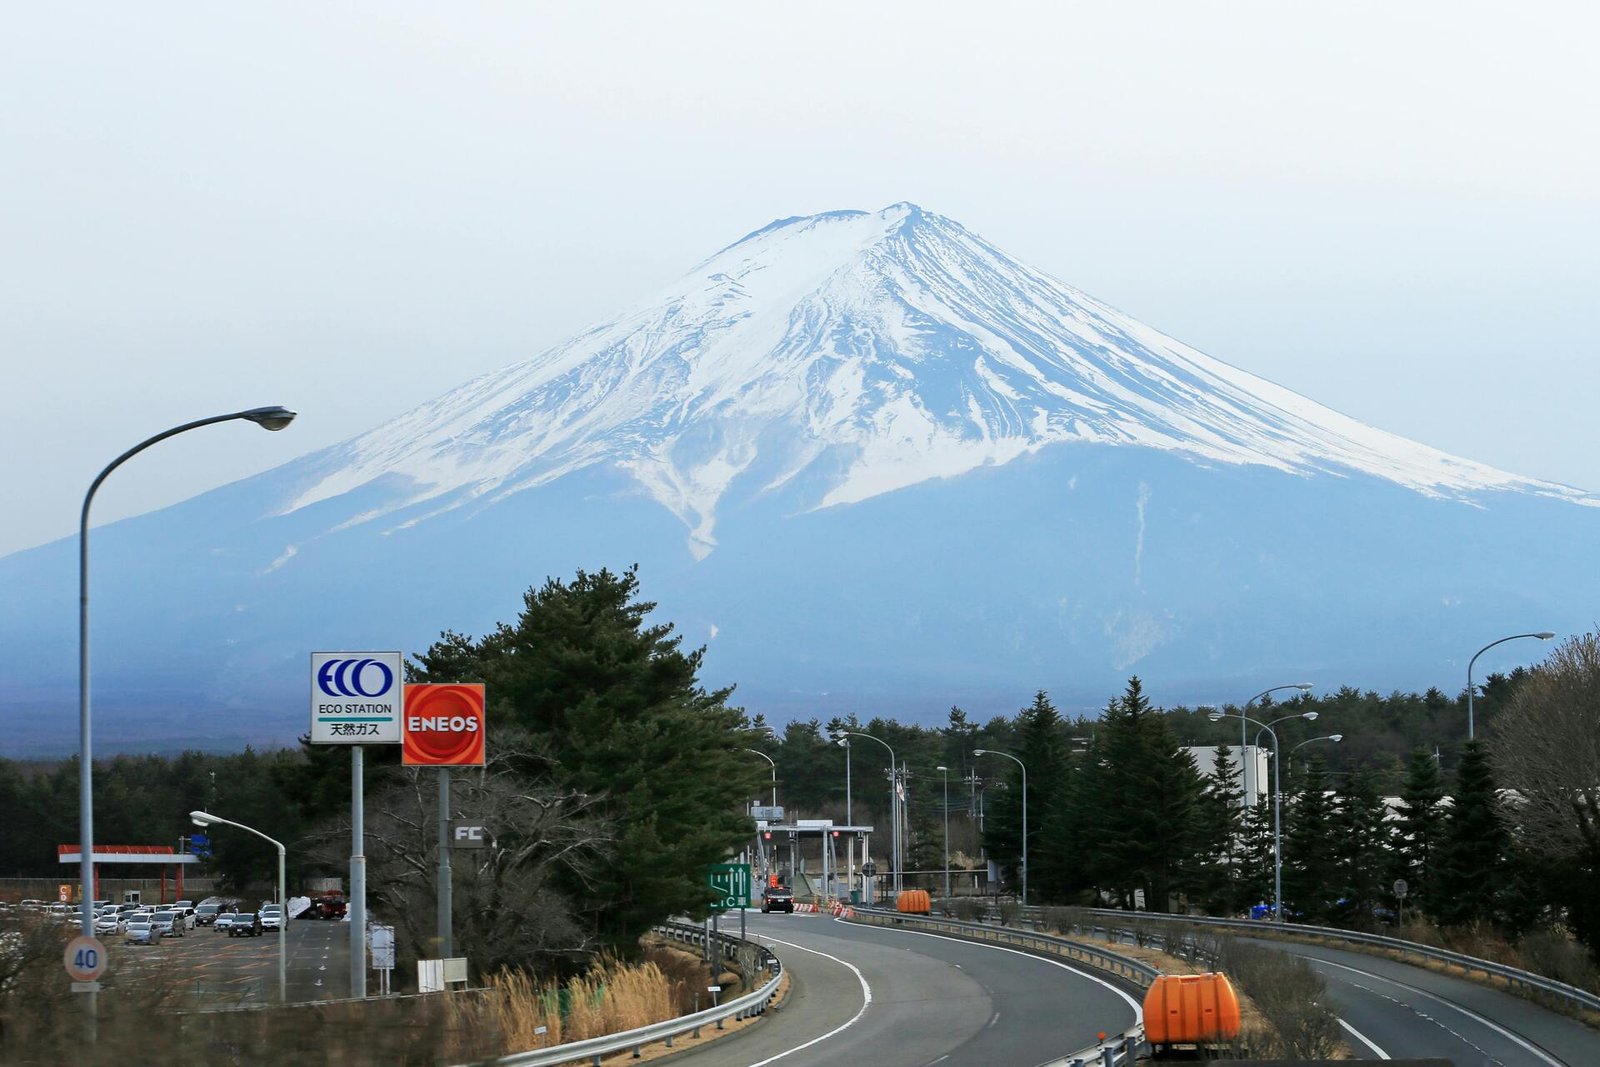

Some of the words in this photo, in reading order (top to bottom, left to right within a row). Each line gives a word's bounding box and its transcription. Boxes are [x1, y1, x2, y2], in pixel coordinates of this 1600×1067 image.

[319, 704, 342, 714] ECO
[345, 704, 392, 714] STATION
[330, 723, 380, 736] 天然ガス
[408, 716, 478, 732] ENEOS
[455, 826, 483, 840] FC
[74, 949, 98, 968] 40
